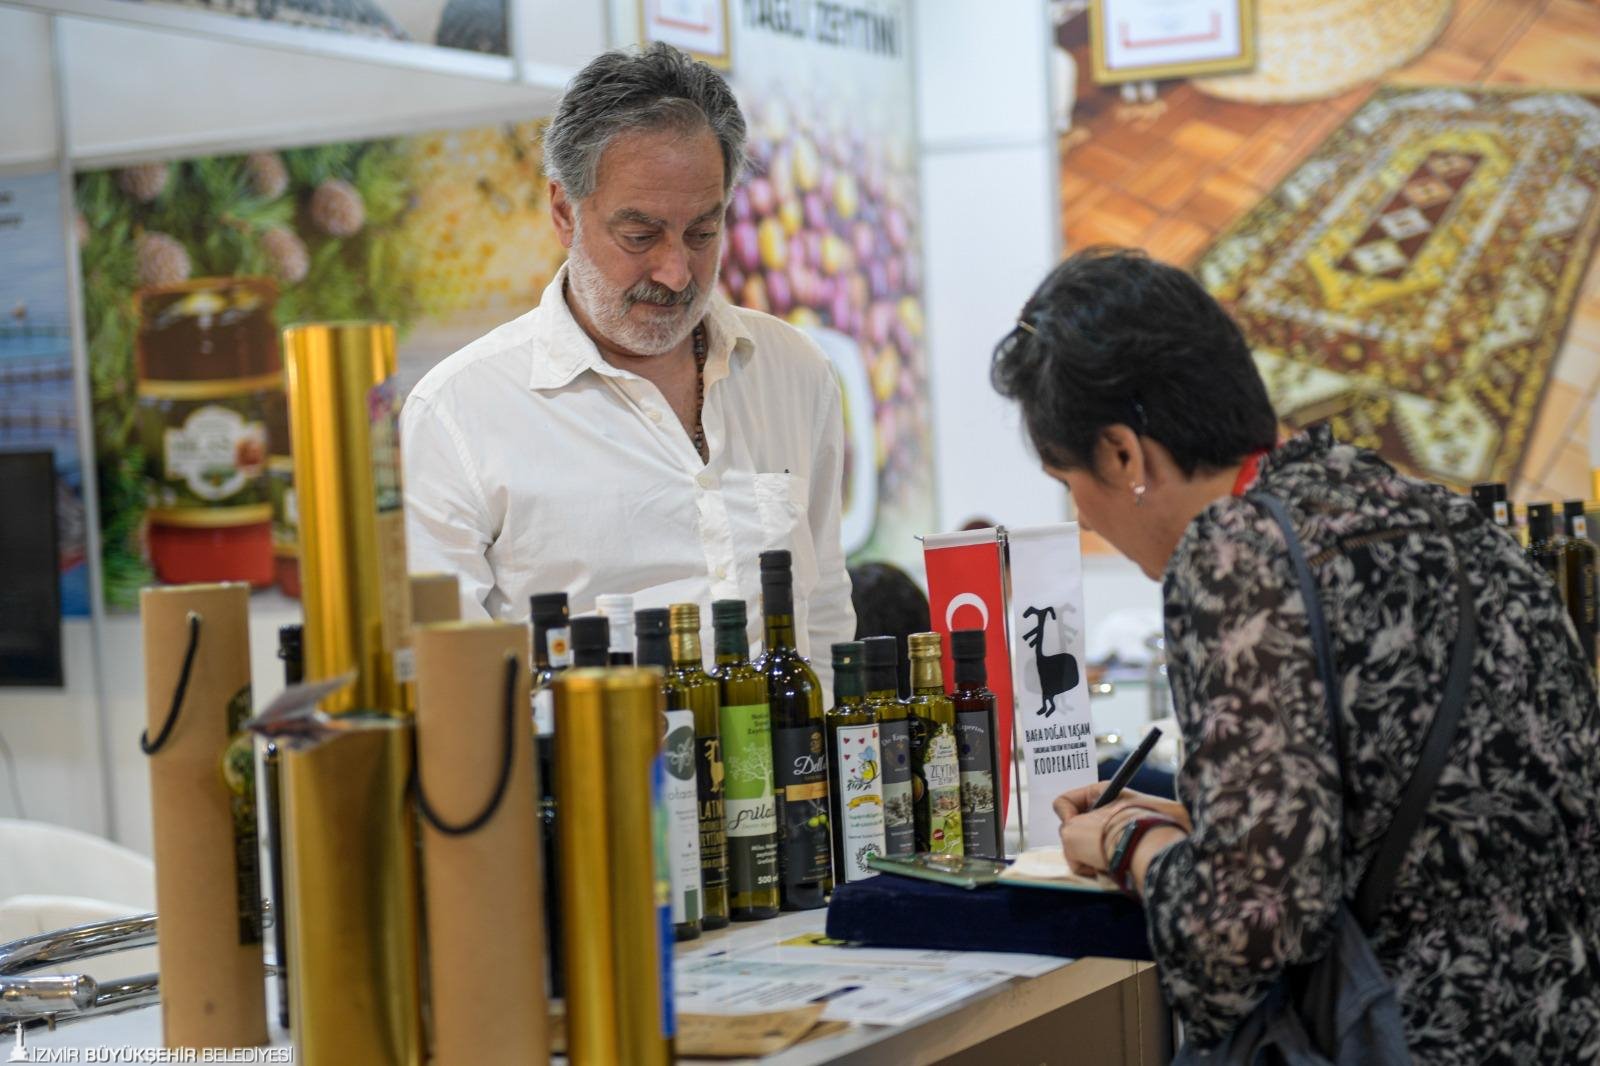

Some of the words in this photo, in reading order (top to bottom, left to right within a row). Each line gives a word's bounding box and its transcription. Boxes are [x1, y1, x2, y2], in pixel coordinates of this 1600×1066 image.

[1025, 728, 1044, 743] BAFA
[1044, 723, 1067, 741] DOĞAL
[1067, 721, 1091, 741] YAŞAM
[1033, 749, 1090, 775] KOOPERATİFİ
[757, 875, 772, 885] 500
